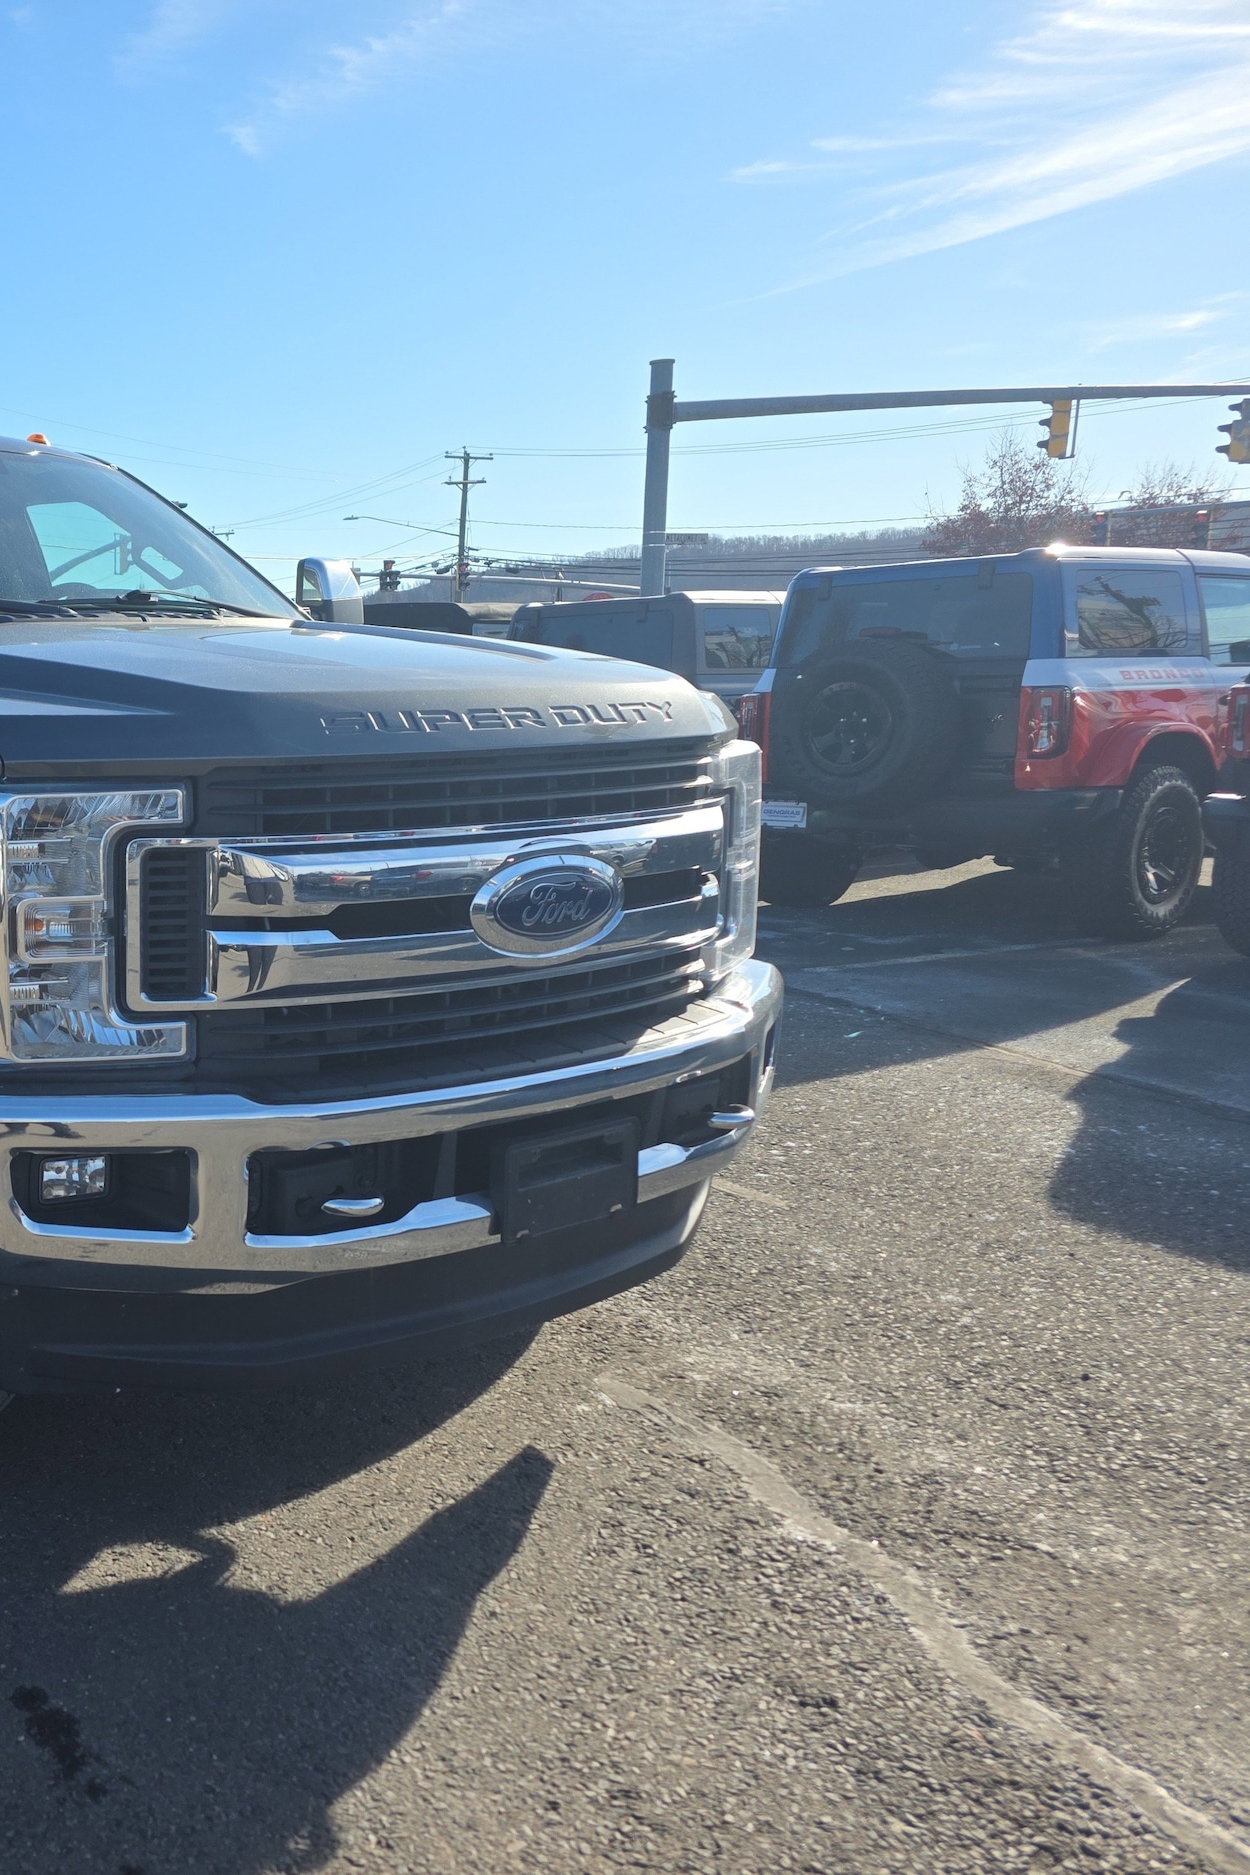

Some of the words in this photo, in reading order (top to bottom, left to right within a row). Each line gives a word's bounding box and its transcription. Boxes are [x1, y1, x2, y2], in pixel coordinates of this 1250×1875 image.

[1119, 668, 1205, 680] BRONCO
[320, 707, 547, 735] SUPER
[548, 701, 672, 728] DUTY
[521, 881, 593, 927] Ford
